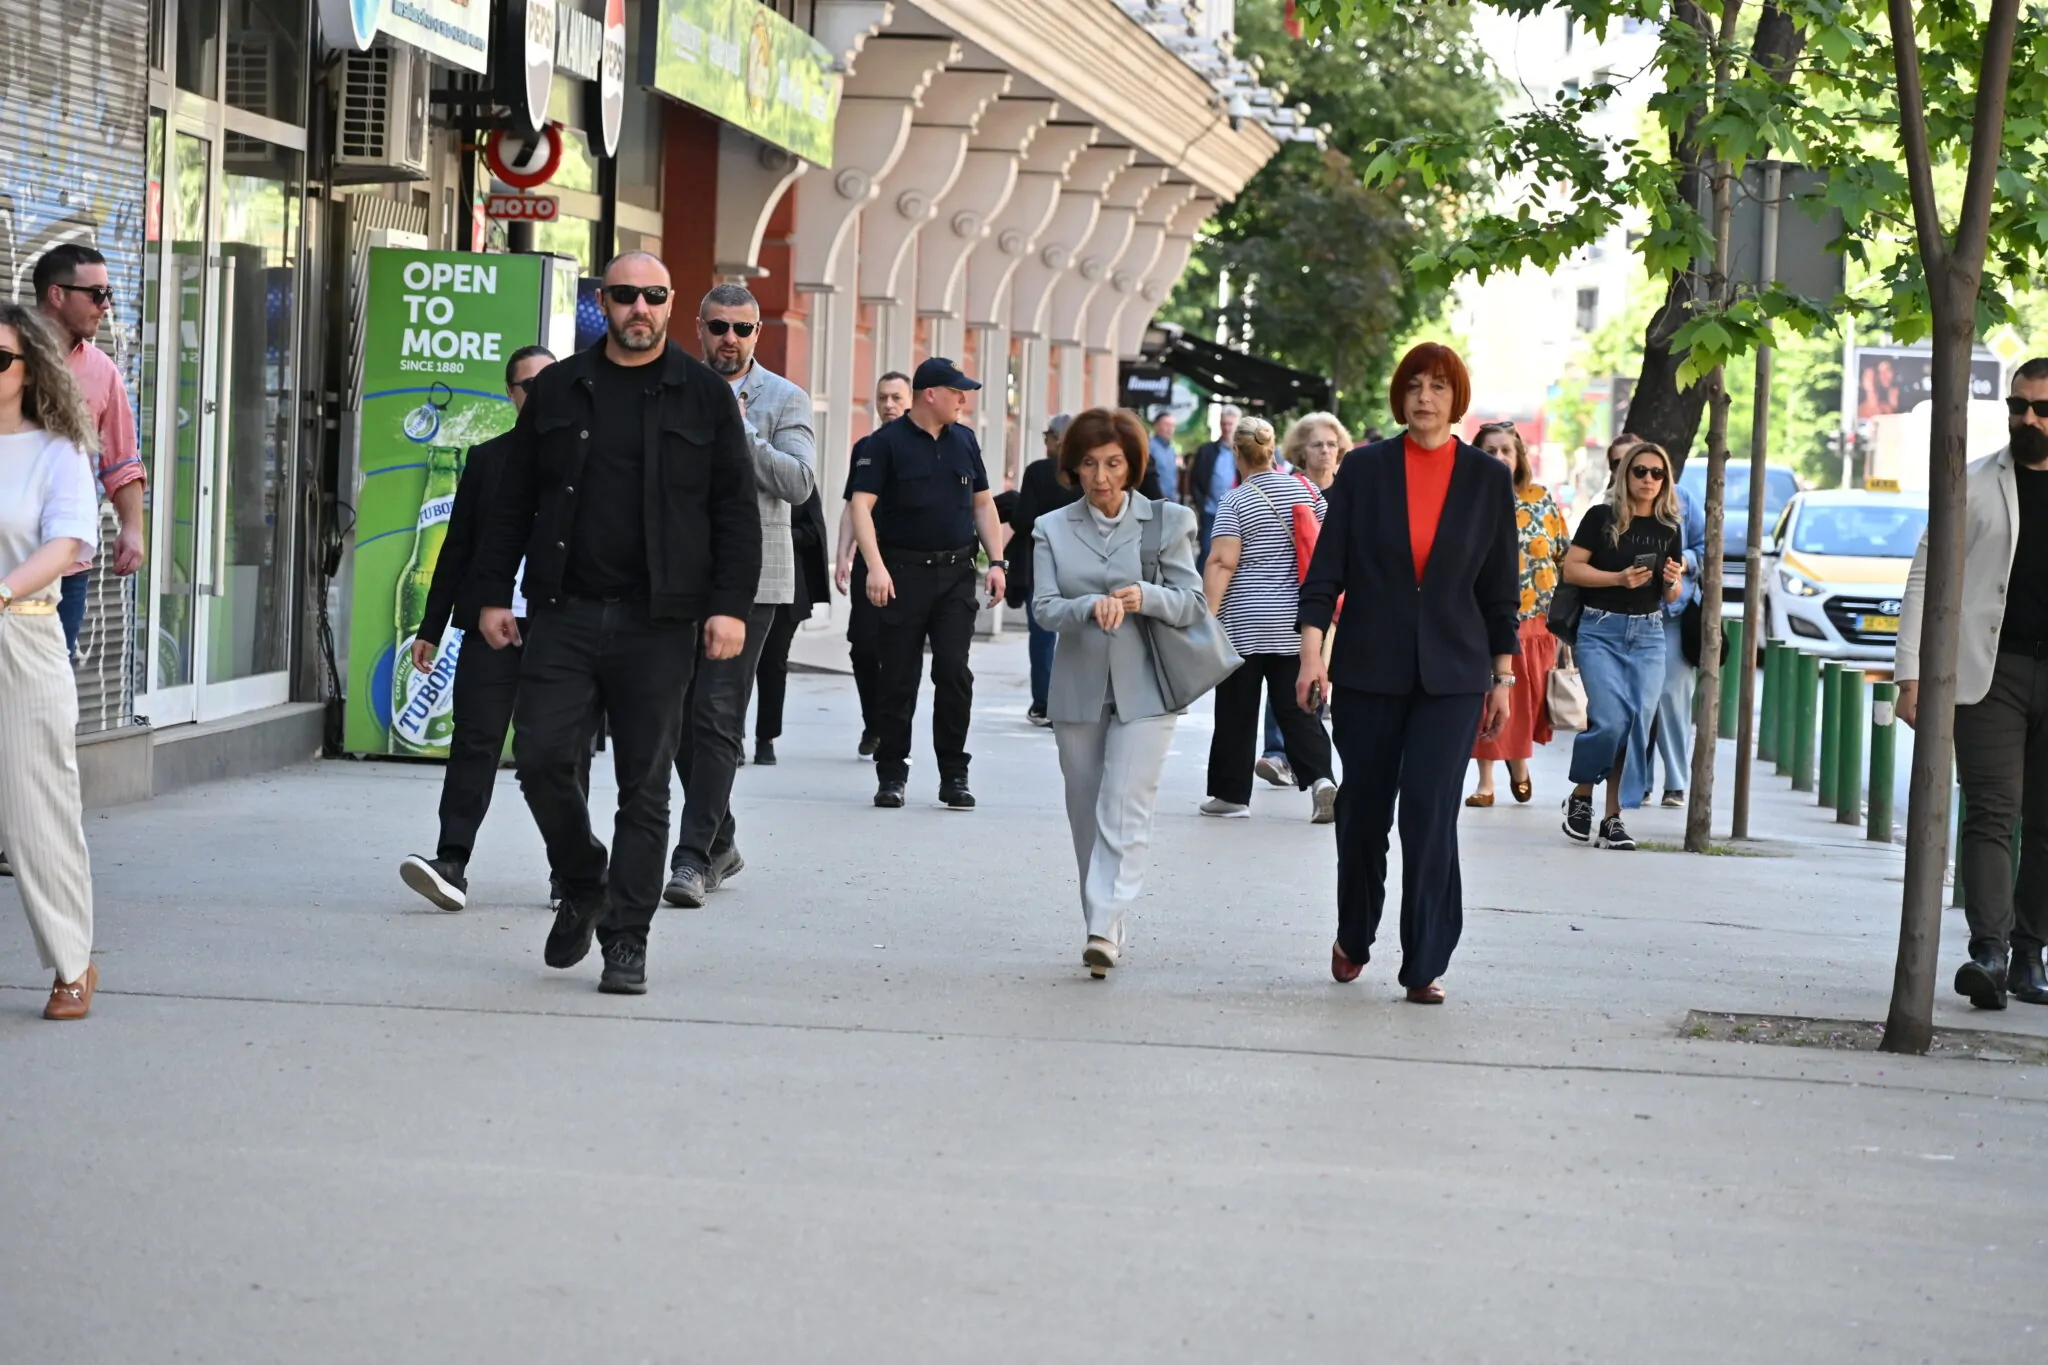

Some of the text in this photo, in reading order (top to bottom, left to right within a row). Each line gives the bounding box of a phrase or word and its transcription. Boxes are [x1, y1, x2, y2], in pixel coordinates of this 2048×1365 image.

[529, 2, 553, 49] PEPSI
[605, 39, 624, 81] PEPSI
[489, 198, 553, 216] ЛОТО
[403, 261, 497, 294] OPEN
[403, 295, 454, 325] TO
[401, 328, 502, 361] MORE
[400, 359, 464, 373] SINCE 1880
[396, 655, 412, 700] COPENHA
